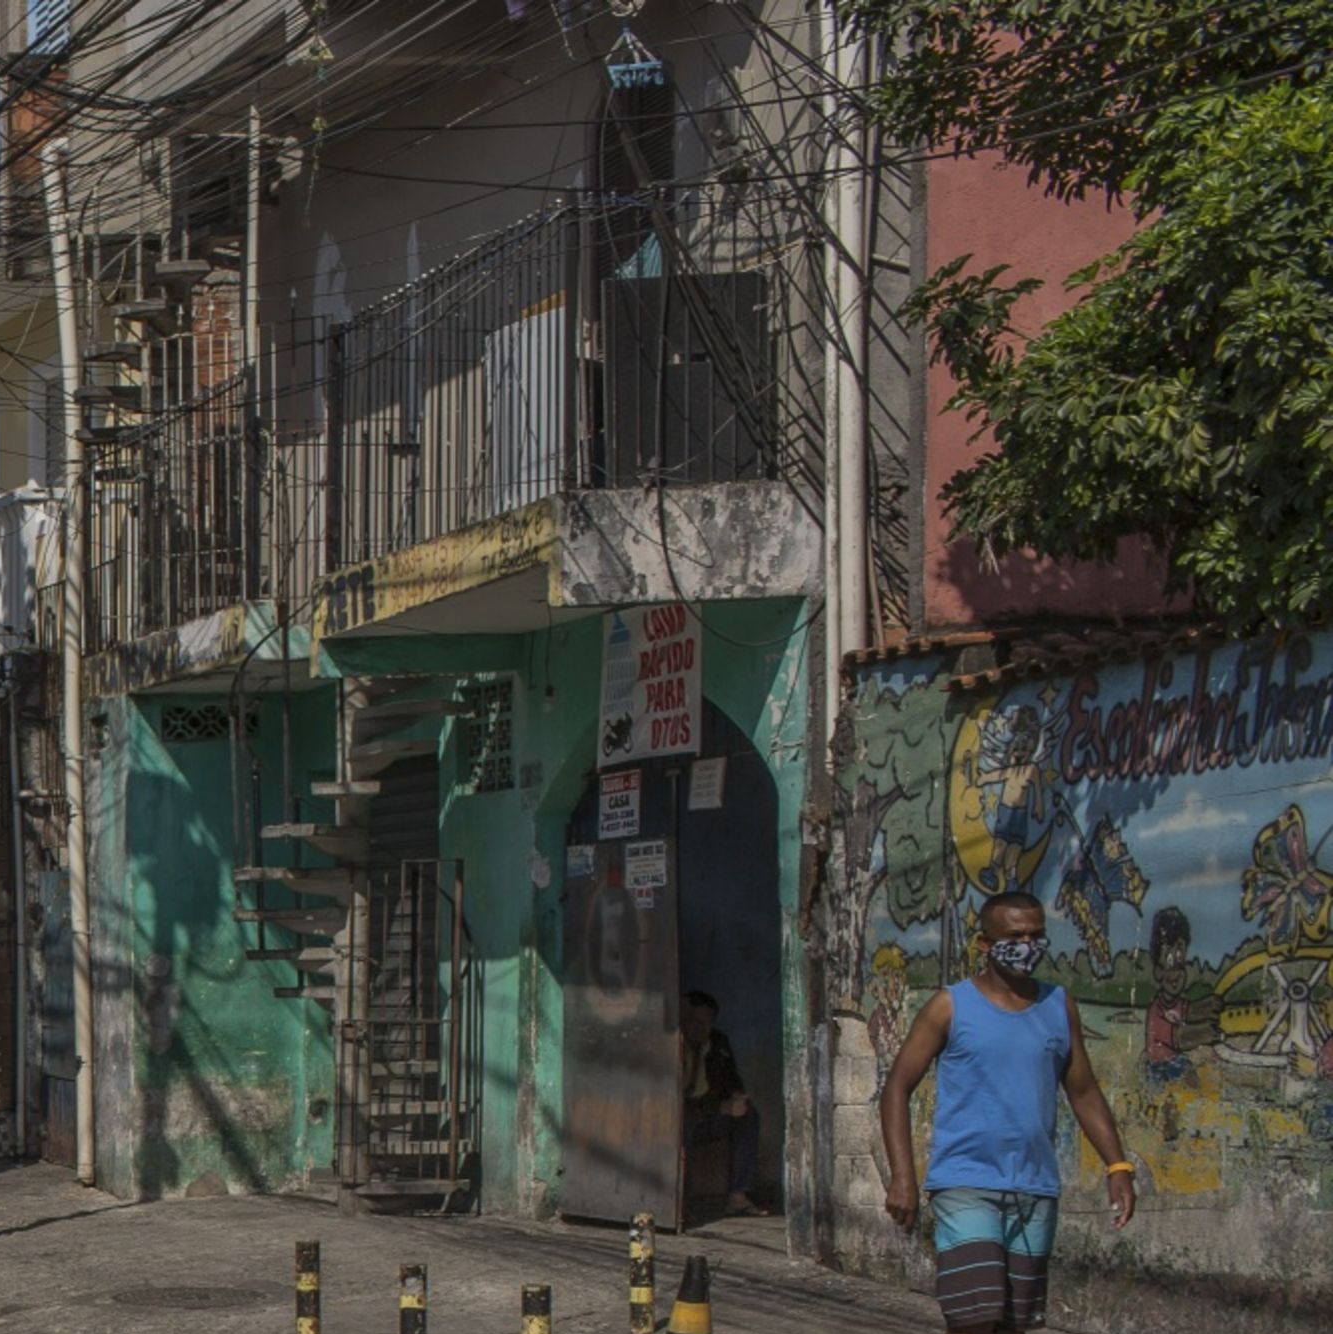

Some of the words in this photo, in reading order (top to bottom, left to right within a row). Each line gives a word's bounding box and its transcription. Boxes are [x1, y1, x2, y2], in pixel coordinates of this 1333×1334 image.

[644, 677, 687, 714] PARA
[1060, 646, 1235, 785] Escolinha
[607, 795, 631, 811] CASA
